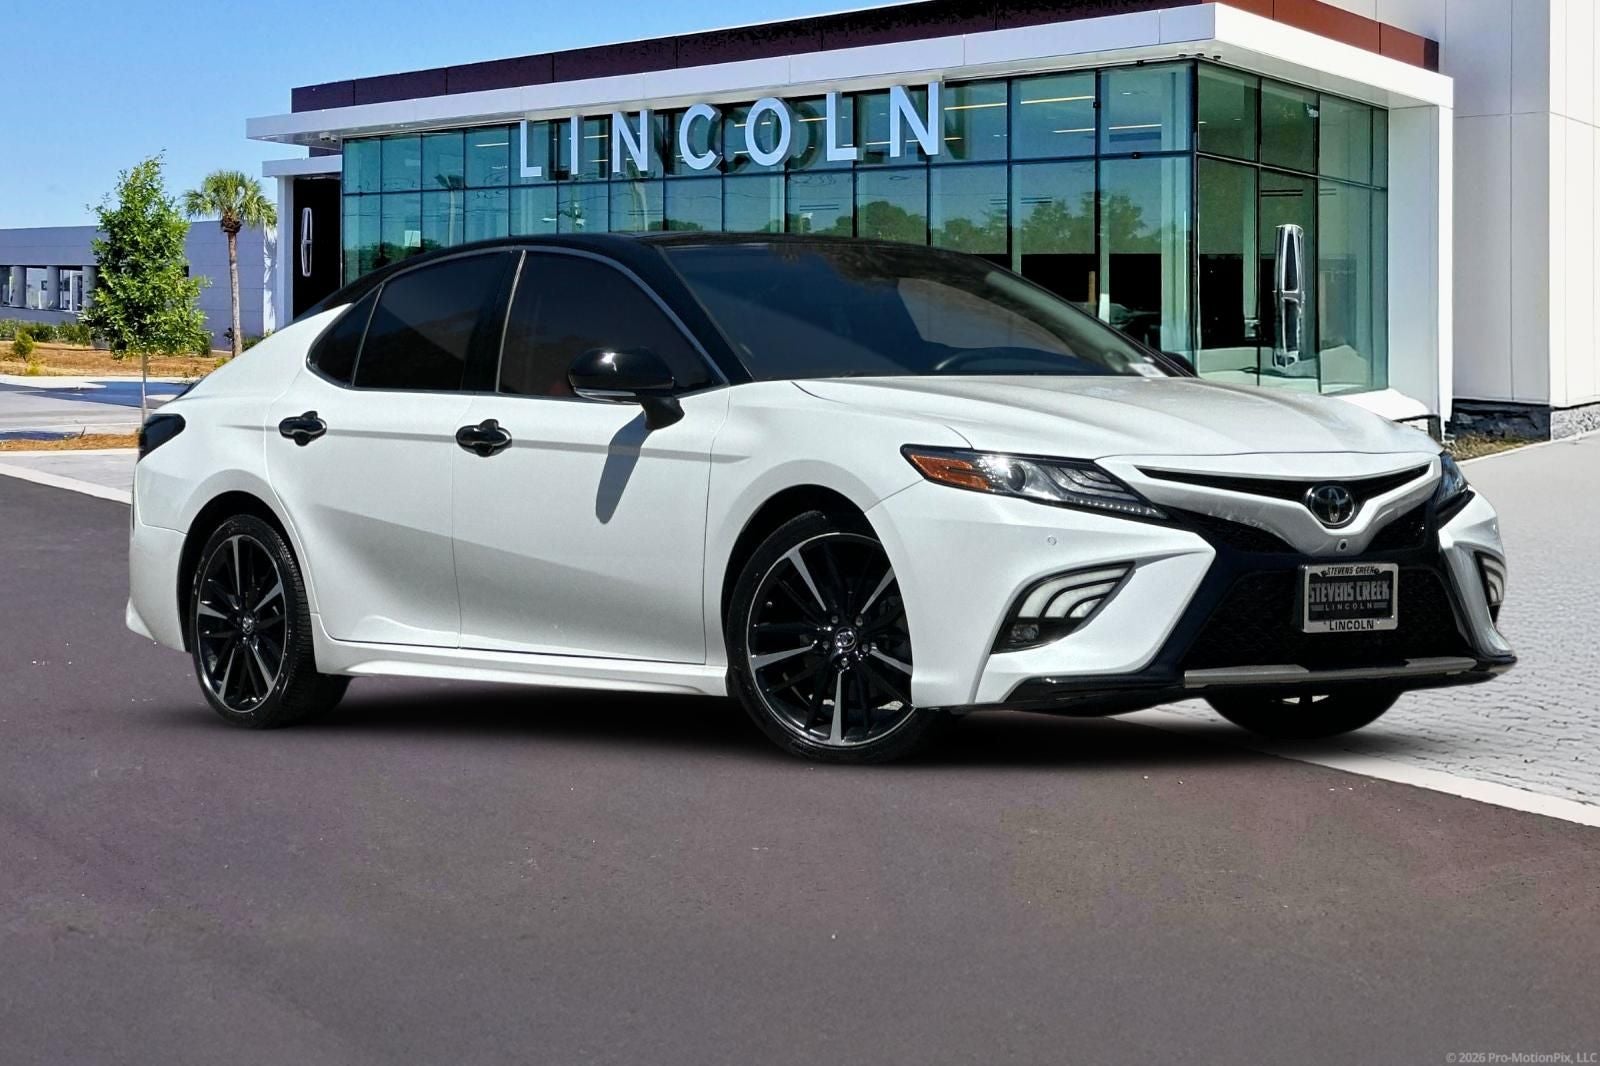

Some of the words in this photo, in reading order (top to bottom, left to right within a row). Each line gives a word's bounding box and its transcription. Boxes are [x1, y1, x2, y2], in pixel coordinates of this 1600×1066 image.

[520, 82, 940, 178] LINCOLN
[1327, 566, 1354, 576] STEVENS
[1355, 565, 1376, 575] CREEK
[1309, 582, 1354, 603] STEVENS
[1356, 580, 1390, 601] CREEK
[1325, 602, 1373, 611] LINCOLN
[1329, 619, 1374, 631] LINCOLN
